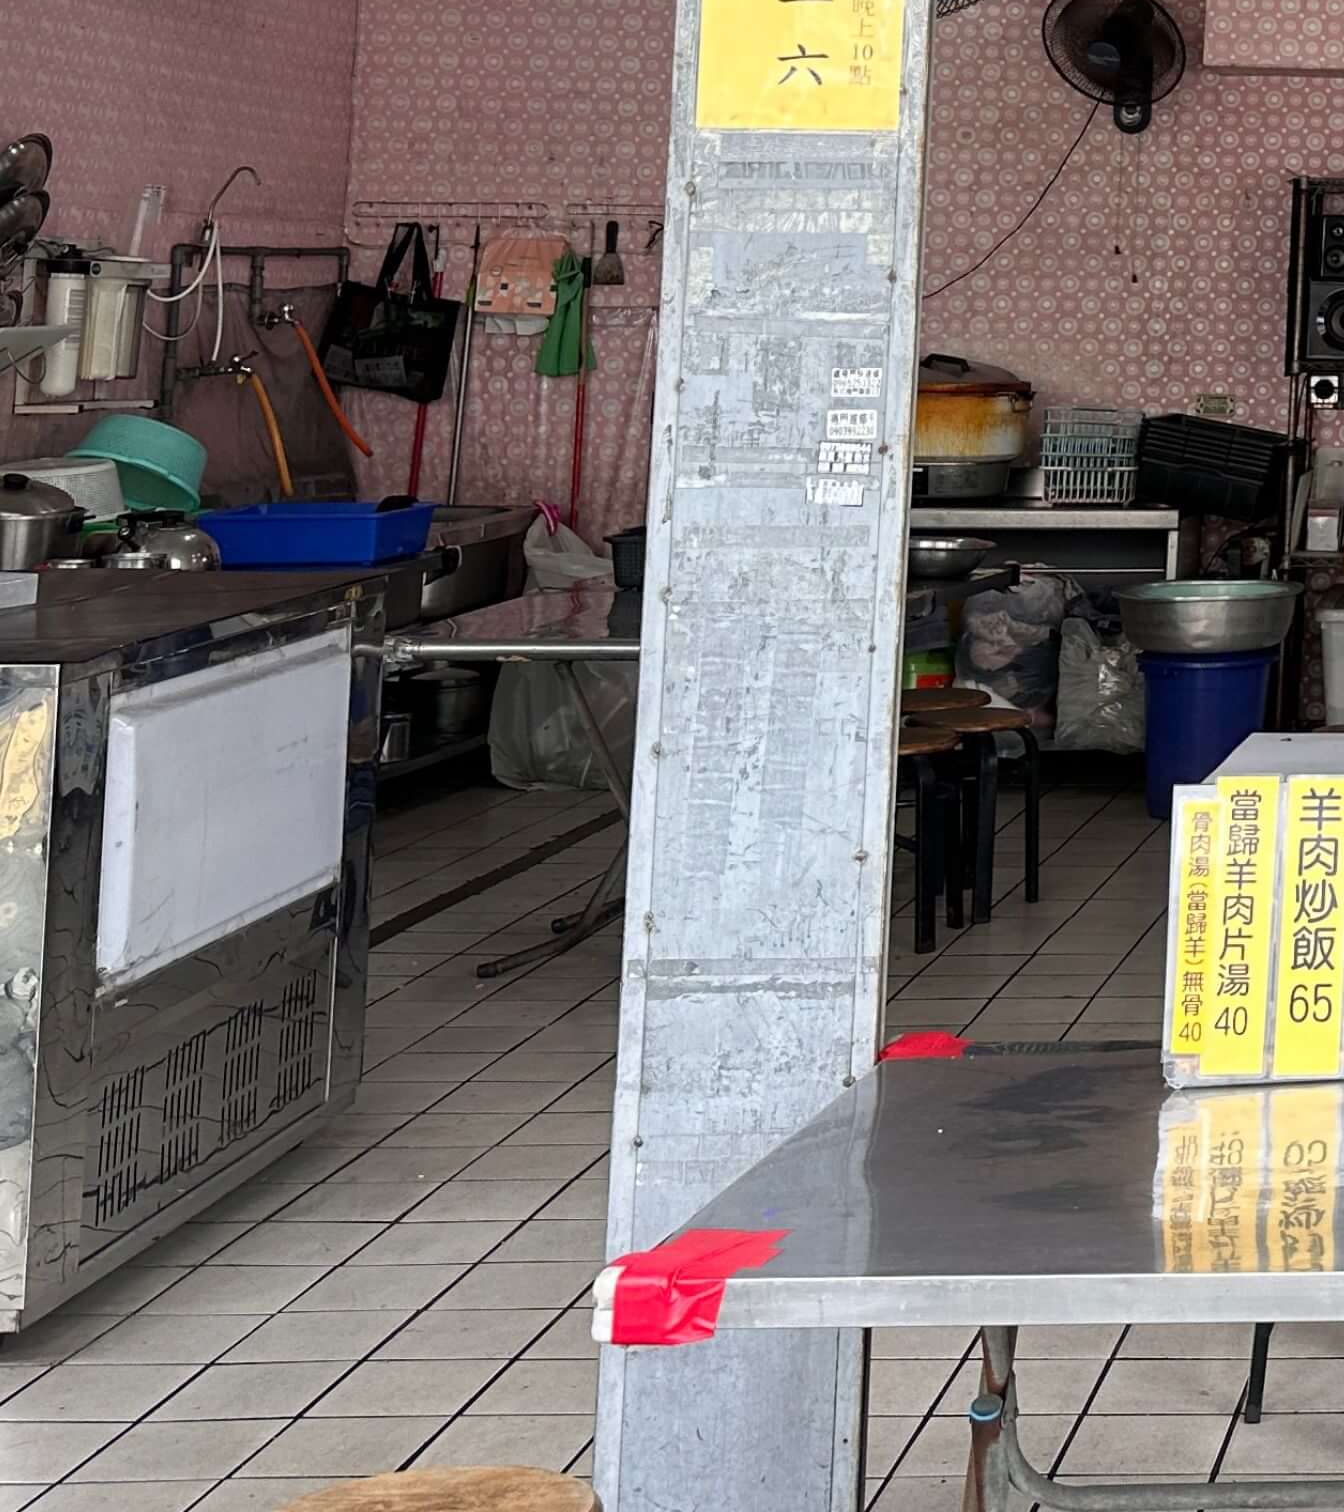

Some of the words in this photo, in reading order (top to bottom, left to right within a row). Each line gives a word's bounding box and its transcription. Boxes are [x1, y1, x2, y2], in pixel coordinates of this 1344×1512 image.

[1216, 789, 1262, 997] 當歸羊肉片湯
[1291, 787, 1342, 971] 羊肉炒飯
[1214, 1006, 1249, 1037] 40
[1289, 984, 1333, 1023] 65
[1178, 1021, 1202, 1042] 40
